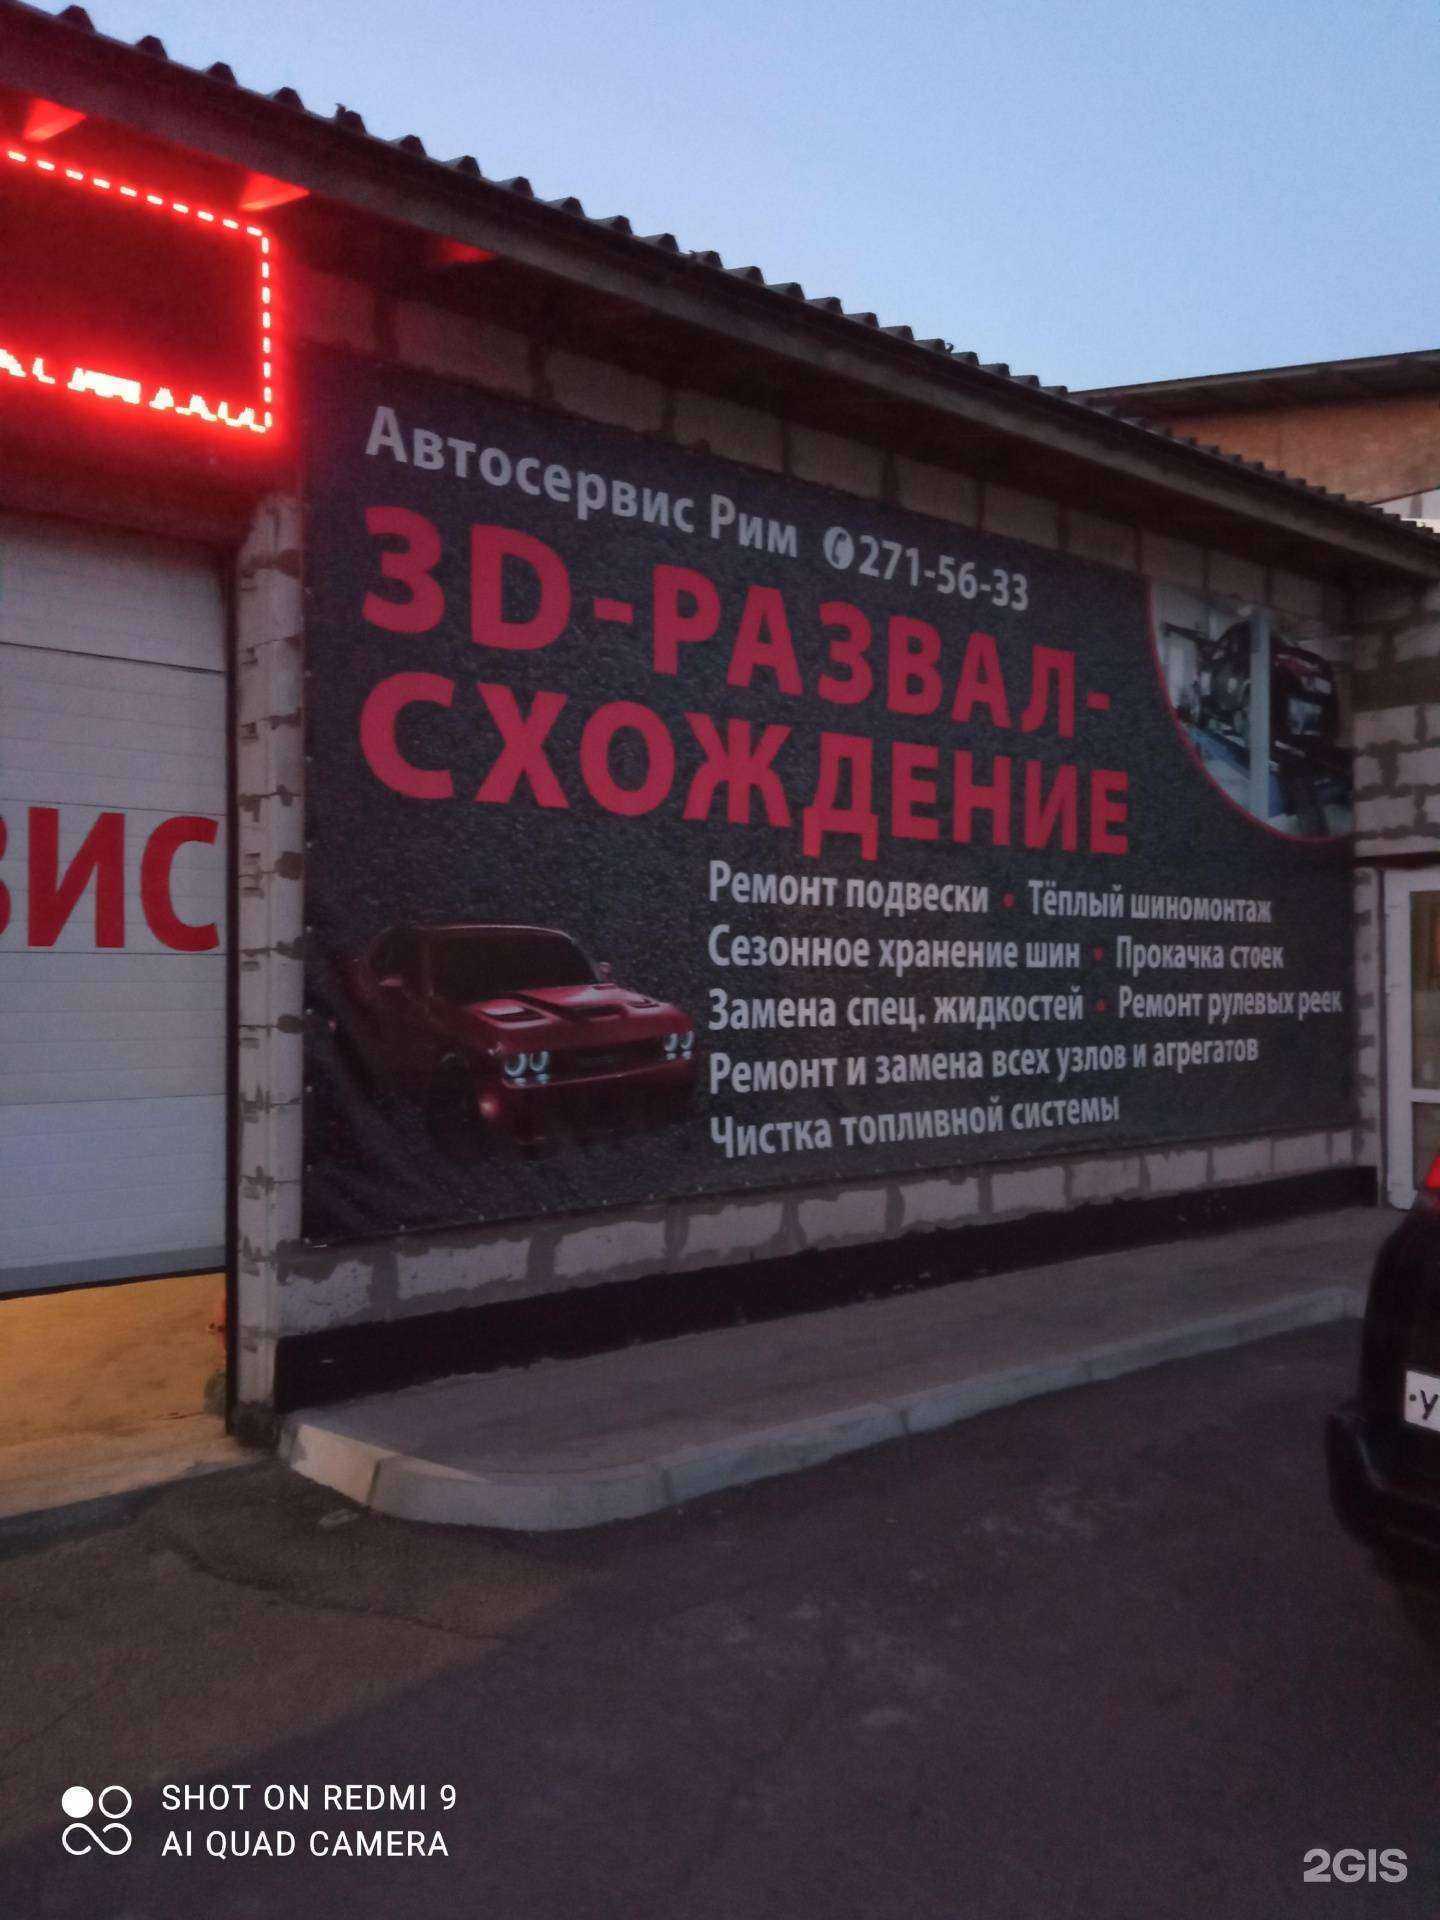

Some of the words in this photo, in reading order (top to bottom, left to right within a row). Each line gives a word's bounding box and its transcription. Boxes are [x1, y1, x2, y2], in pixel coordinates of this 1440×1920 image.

[365, 405, 695, 533] Автосервис
[710, 493, 798, 558] Рим
[858, 534, 1029, 612] 271-56-33
[359, 672, 1129, 861] СХОЖДЕНИЕ
[0, 807, 220, 952] ИС
[709, 860, 838, 906] Ремонт
[846, 878, 988, 917] подвески
[1028, 879, 1124, 918] Тёплый
[1131, 894, 1273, 923] шиномонтаж
[708, 924, 870, 966] Сезонное
[878, 938, 1018, 977] хранение
[1025, 942, 1080, 968] шин
[1116, 935, 1225, 977] Прокачка
[1230, 946, 1285, 969] стоек
[708, 988, 836, 1030] Замена
[847, 997, 926, 1032] спец.
[933, 985, 1084, 1030] жидкостей
[1118, 985, 1204, 1019] Ремонт
[1207, 990, 1295, 1025] рулевых
[1298, 990, 1343, 1020] реек
[709, 1053, 838, 1094] Ремонт
[846, 1057, 867, 1086] и
[875, 1050, 984, 1083] замена
[992, 1045, 1050, 1077] всех
[1056, 1042, 1126, 1082] узлов
[1132, 1043, 1147, 1069] и
[1153, 1038, 1259, 1073] агрегатов
[710, 1116, 833, 1158] Чистка
[840, 1095, 1004, 1146] топливной
[1010, 1096, 1121, 1130] системы
